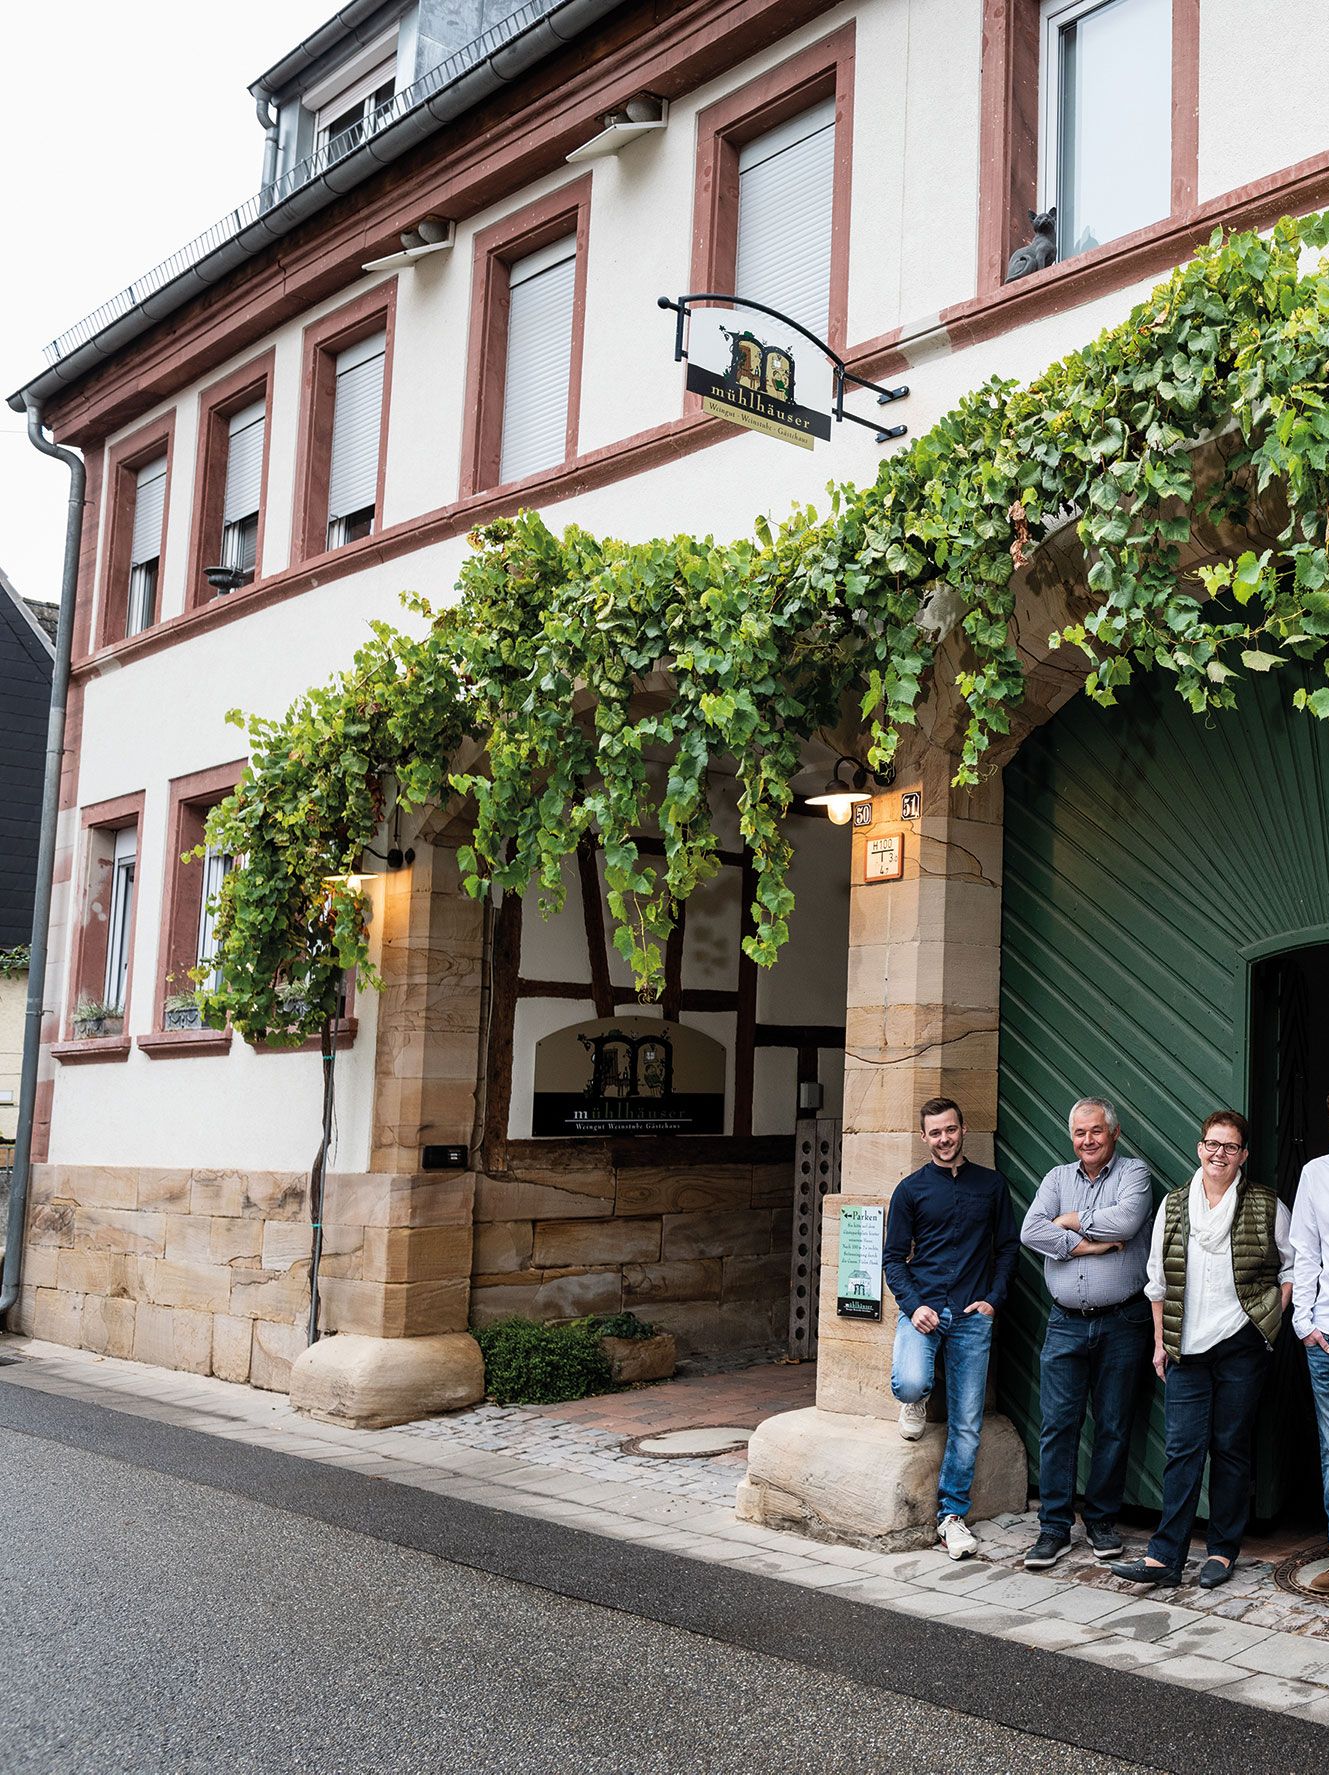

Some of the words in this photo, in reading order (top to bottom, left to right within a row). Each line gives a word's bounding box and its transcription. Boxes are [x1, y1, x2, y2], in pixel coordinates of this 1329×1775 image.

[709, 402, 735, 418] Weingut
[711, 384, 810, 430] mühlhäuser
[856, 805, 869, 824] 50
[903, 796, 916, 816] 51
[574, 1101, 685, 1120] mühlhäuser
[576, 1123, 605, 1131] Weingut
[852, 1210, 878, 1221] Parken
